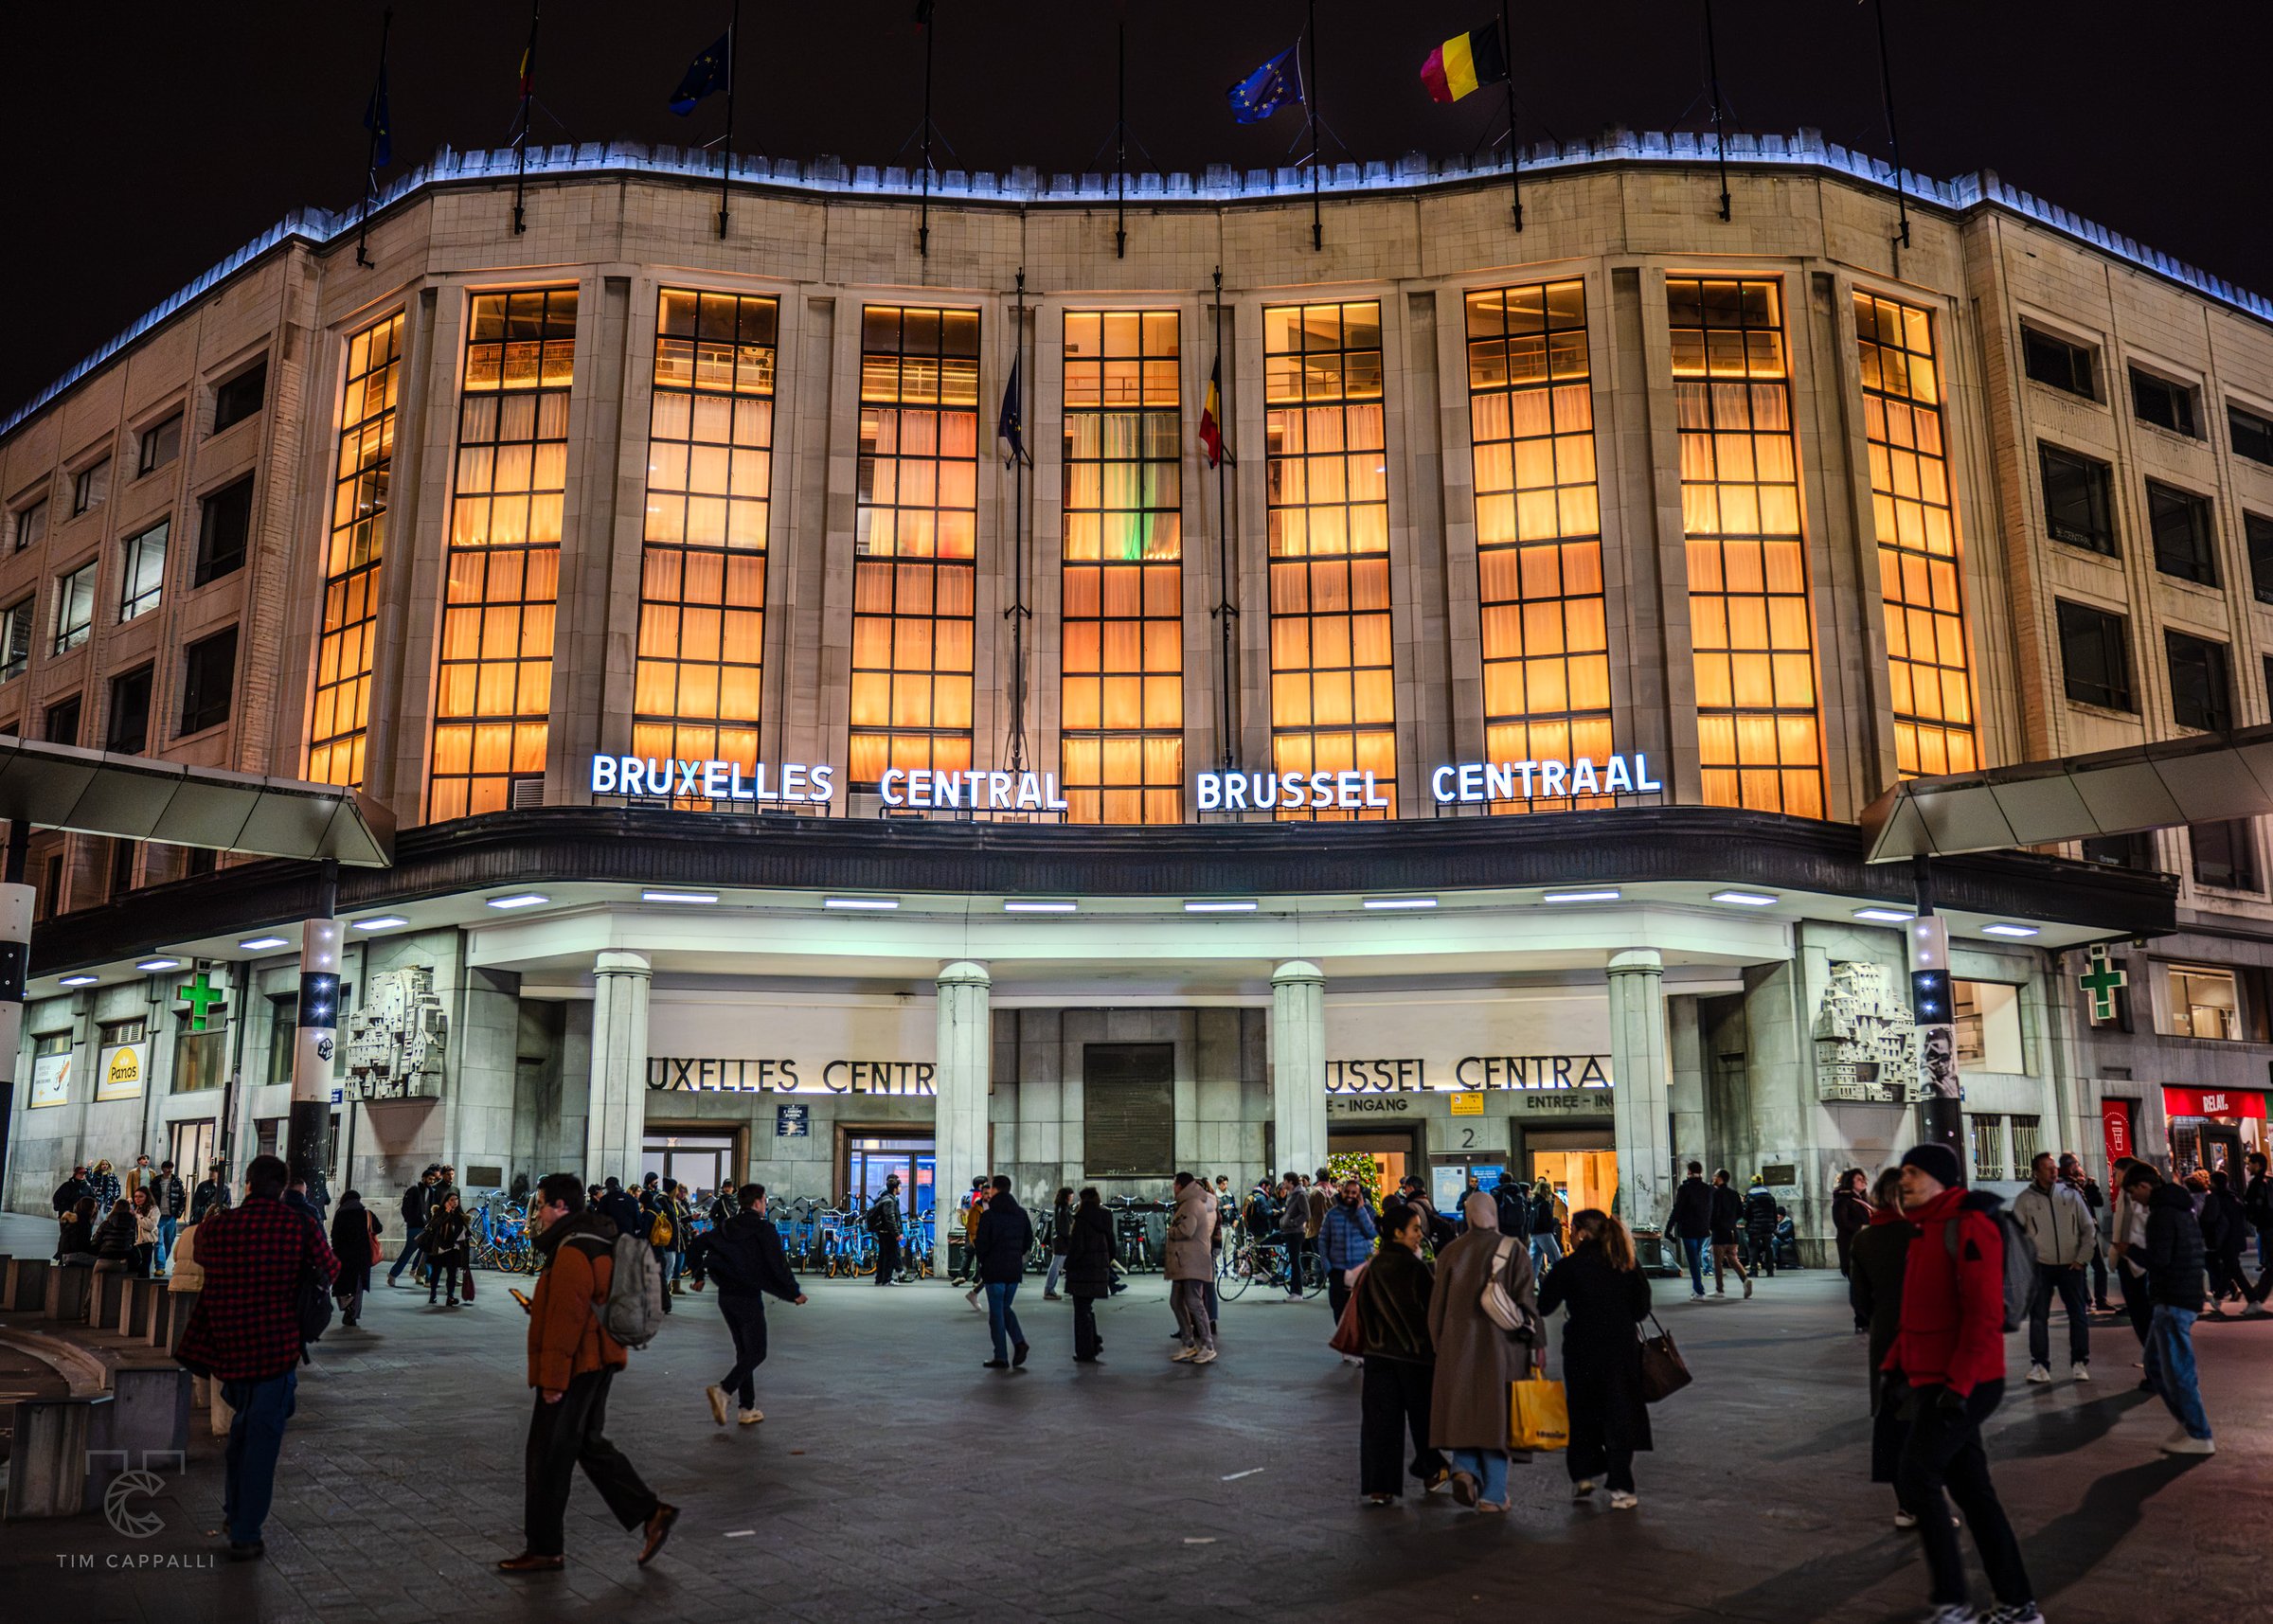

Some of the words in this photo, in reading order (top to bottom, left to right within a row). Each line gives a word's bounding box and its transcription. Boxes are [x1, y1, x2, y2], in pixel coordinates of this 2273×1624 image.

[592, 754, 834, 801] BRUXELLES
[881, 769, 1068, 810] CENTRAL
[1197, 770, 1388, 810] BRUSSEL
[1432, 753, 1662, 803] CENTRAAL
[111, 1065, 136, 1080] Panos
[646, 1057, 799, 1091] UXELLES
[823, 1060, 935, 1095] CENTR
[1326, 1059, 1435, 1092] USSEL
[1456, 1055, 1610, 1089] CENTRA
[1349, 1098, 1408, 1112] INGANG
[1527, 1095, 1579, 1109] ENTREE
[1461, 1128, 1475, 1149] 2
